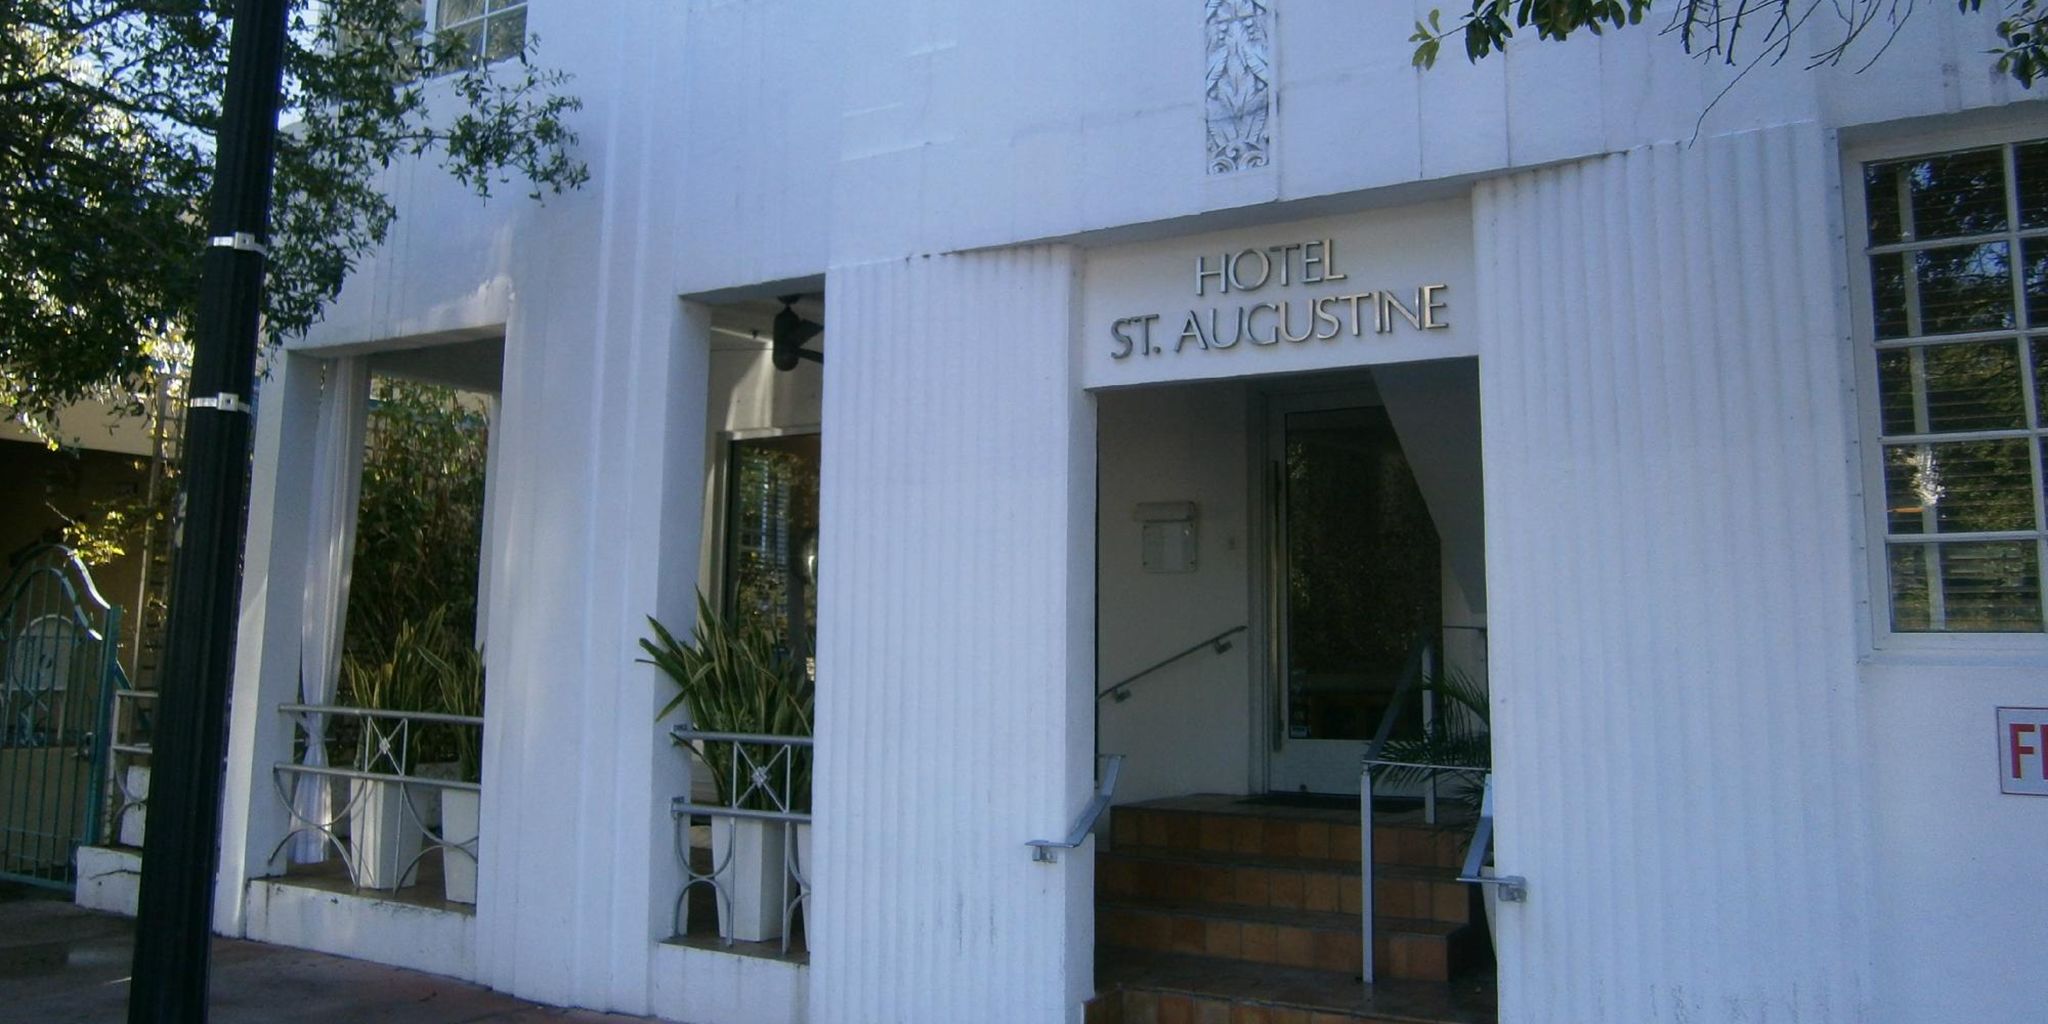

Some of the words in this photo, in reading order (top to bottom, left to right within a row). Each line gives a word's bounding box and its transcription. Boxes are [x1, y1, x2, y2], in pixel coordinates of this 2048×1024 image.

[1195, 238, 1347, 296] HOTEL
[1110, 313, 1162, 360] ST.
[1174, 283, 1450, 353] AUGUSTINE
